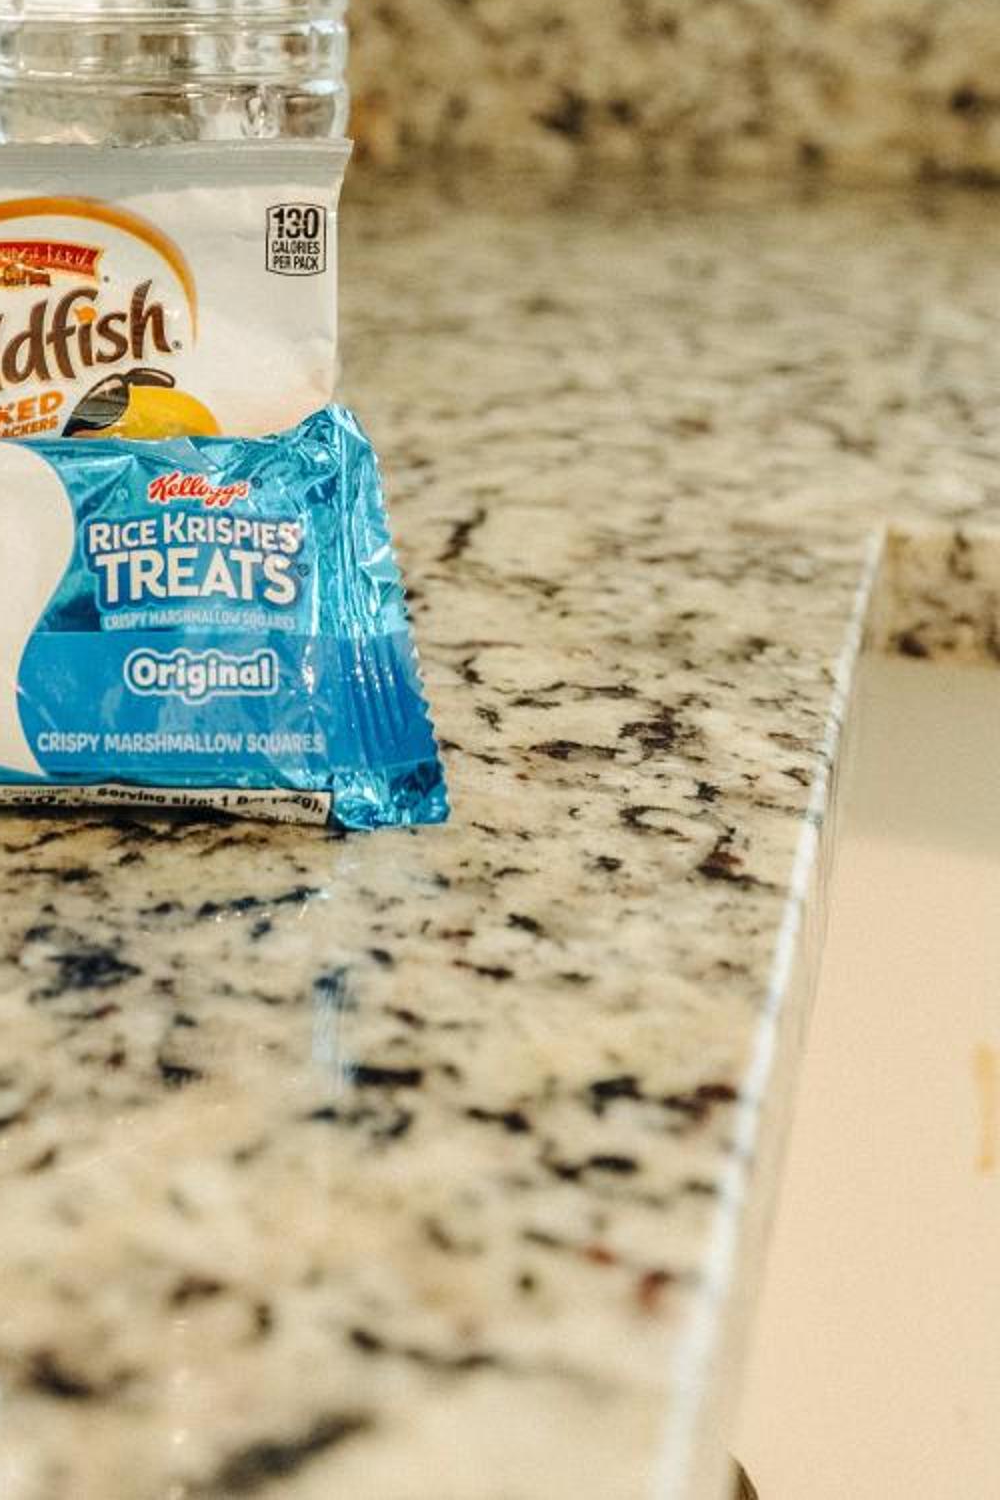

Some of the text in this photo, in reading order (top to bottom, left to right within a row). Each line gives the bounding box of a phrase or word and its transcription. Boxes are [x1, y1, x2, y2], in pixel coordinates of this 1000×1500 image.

[272, 207, 320, 239] 130
[271, 240, 321, 255] CALORIES
[273, 255, 319, 271] PER PACK
[148, 472, 249, 506] Kellogg's
[89, 511, 304, 553] RICE KRISPIES
[95, 547, 297, 605] TREATS
[103, 612, 147, 631] CRISPY
[131, 655, 271, 696] Original
[37, 732, 327, 755] CRISPY MARSHMALLOW SQUARES
